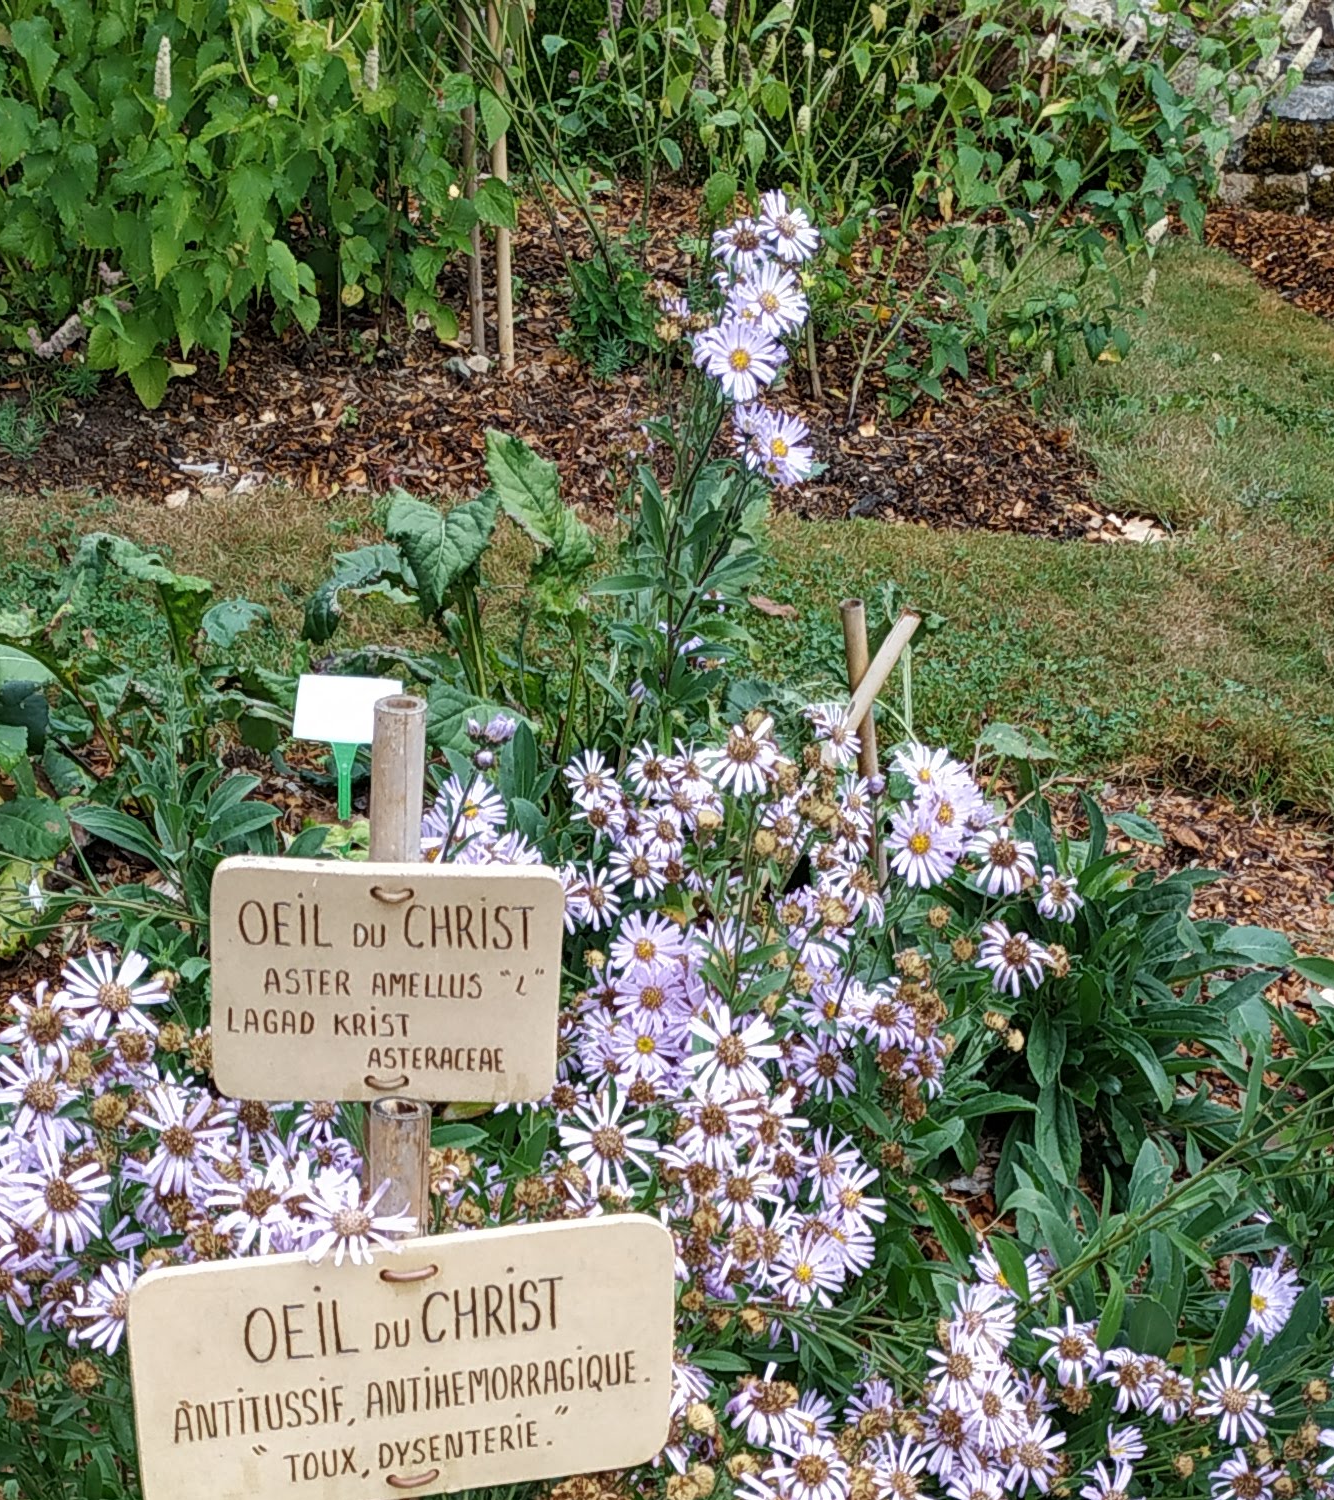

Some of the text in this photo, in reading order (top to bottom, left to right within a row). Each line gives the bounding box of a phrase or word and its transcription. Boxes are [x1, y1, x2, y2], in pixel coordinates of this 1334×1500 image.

[353, 922, 386, 948] DU
[264, 968, 350, 997] ASTER
[371, 971, 483, 999] AMELLUS
[227, 1006, 315, 1034] LAGAD
[367, 1047, 505, 1074] ASTERACEAE
[374, 1318, 410, 1350] DU
